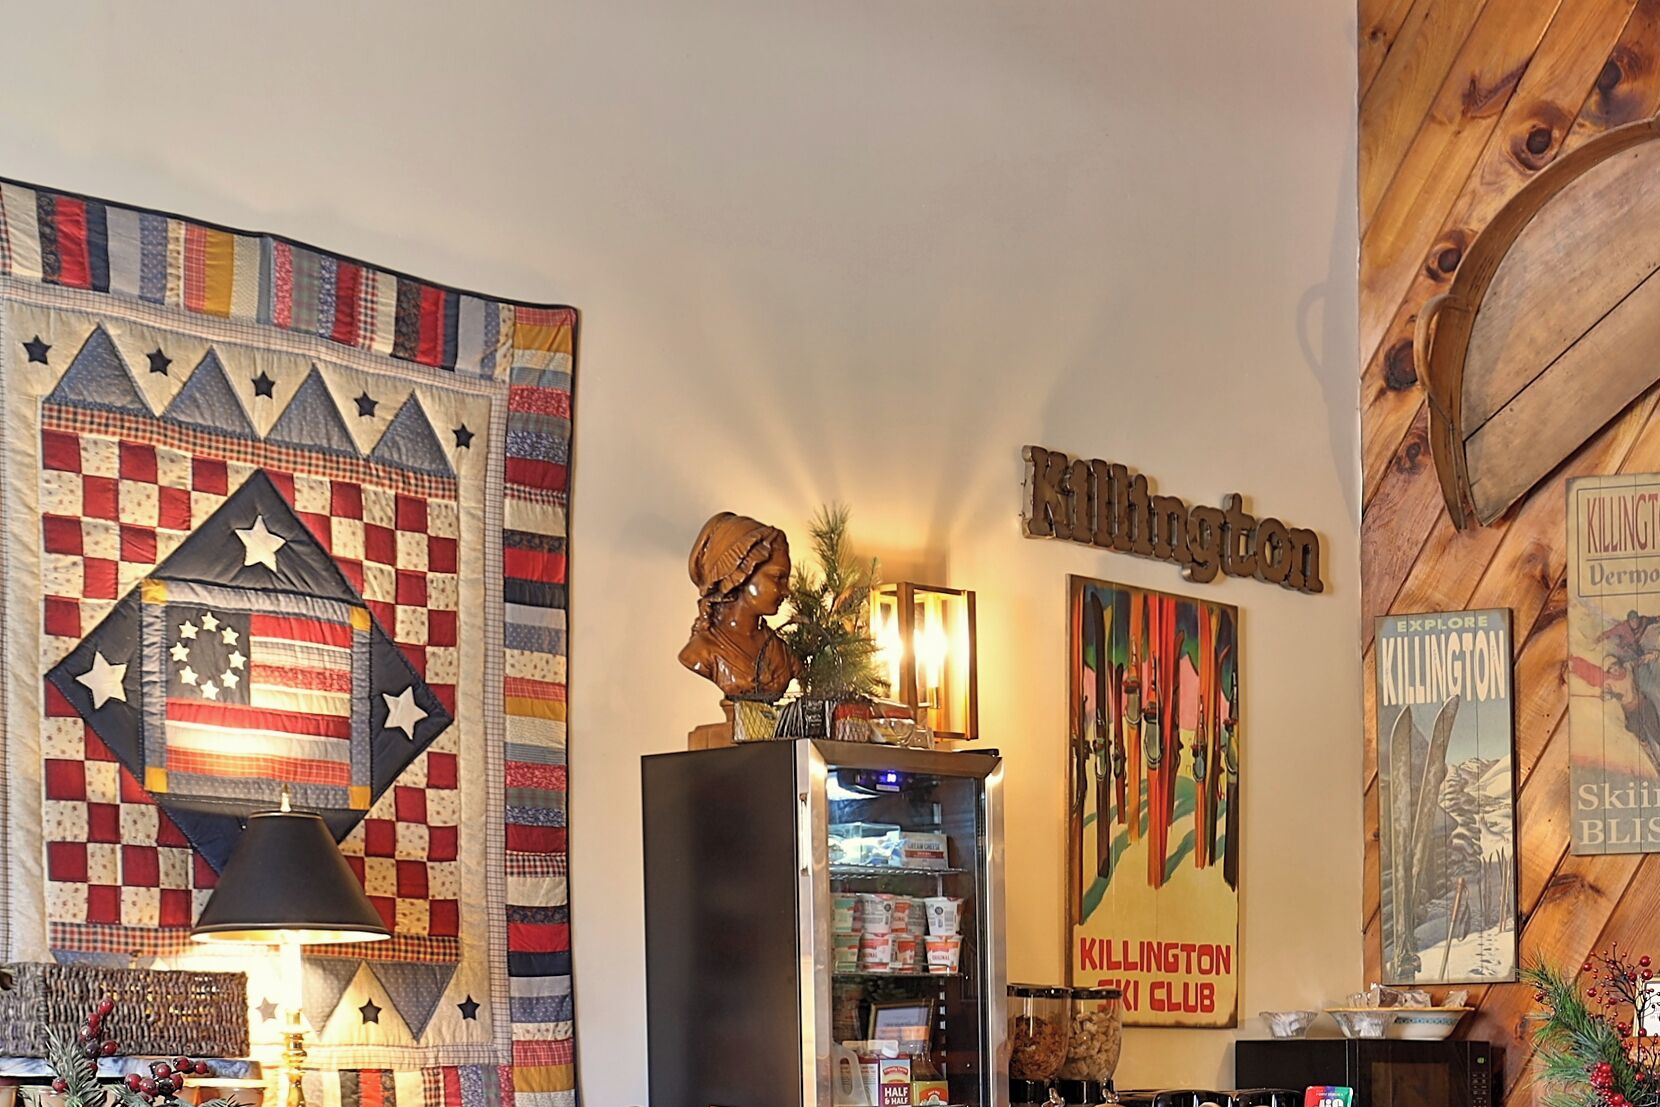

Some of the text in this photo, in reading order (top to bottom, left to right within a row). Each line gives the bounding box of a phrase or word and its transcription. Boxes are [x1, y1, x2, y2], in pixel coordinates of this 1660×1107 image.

[1021, 445, 1325, 594] Killington
[1396, 615, 1488, 633] EXPLORE
[1381, 629, 1505, 707] KILLINGTON
[1080, 937, 1232, 976] KILLINGTON
[1097, 979, 1215, 1013] SKI CLUB
[884, 1087, 908, 1097] HALF
